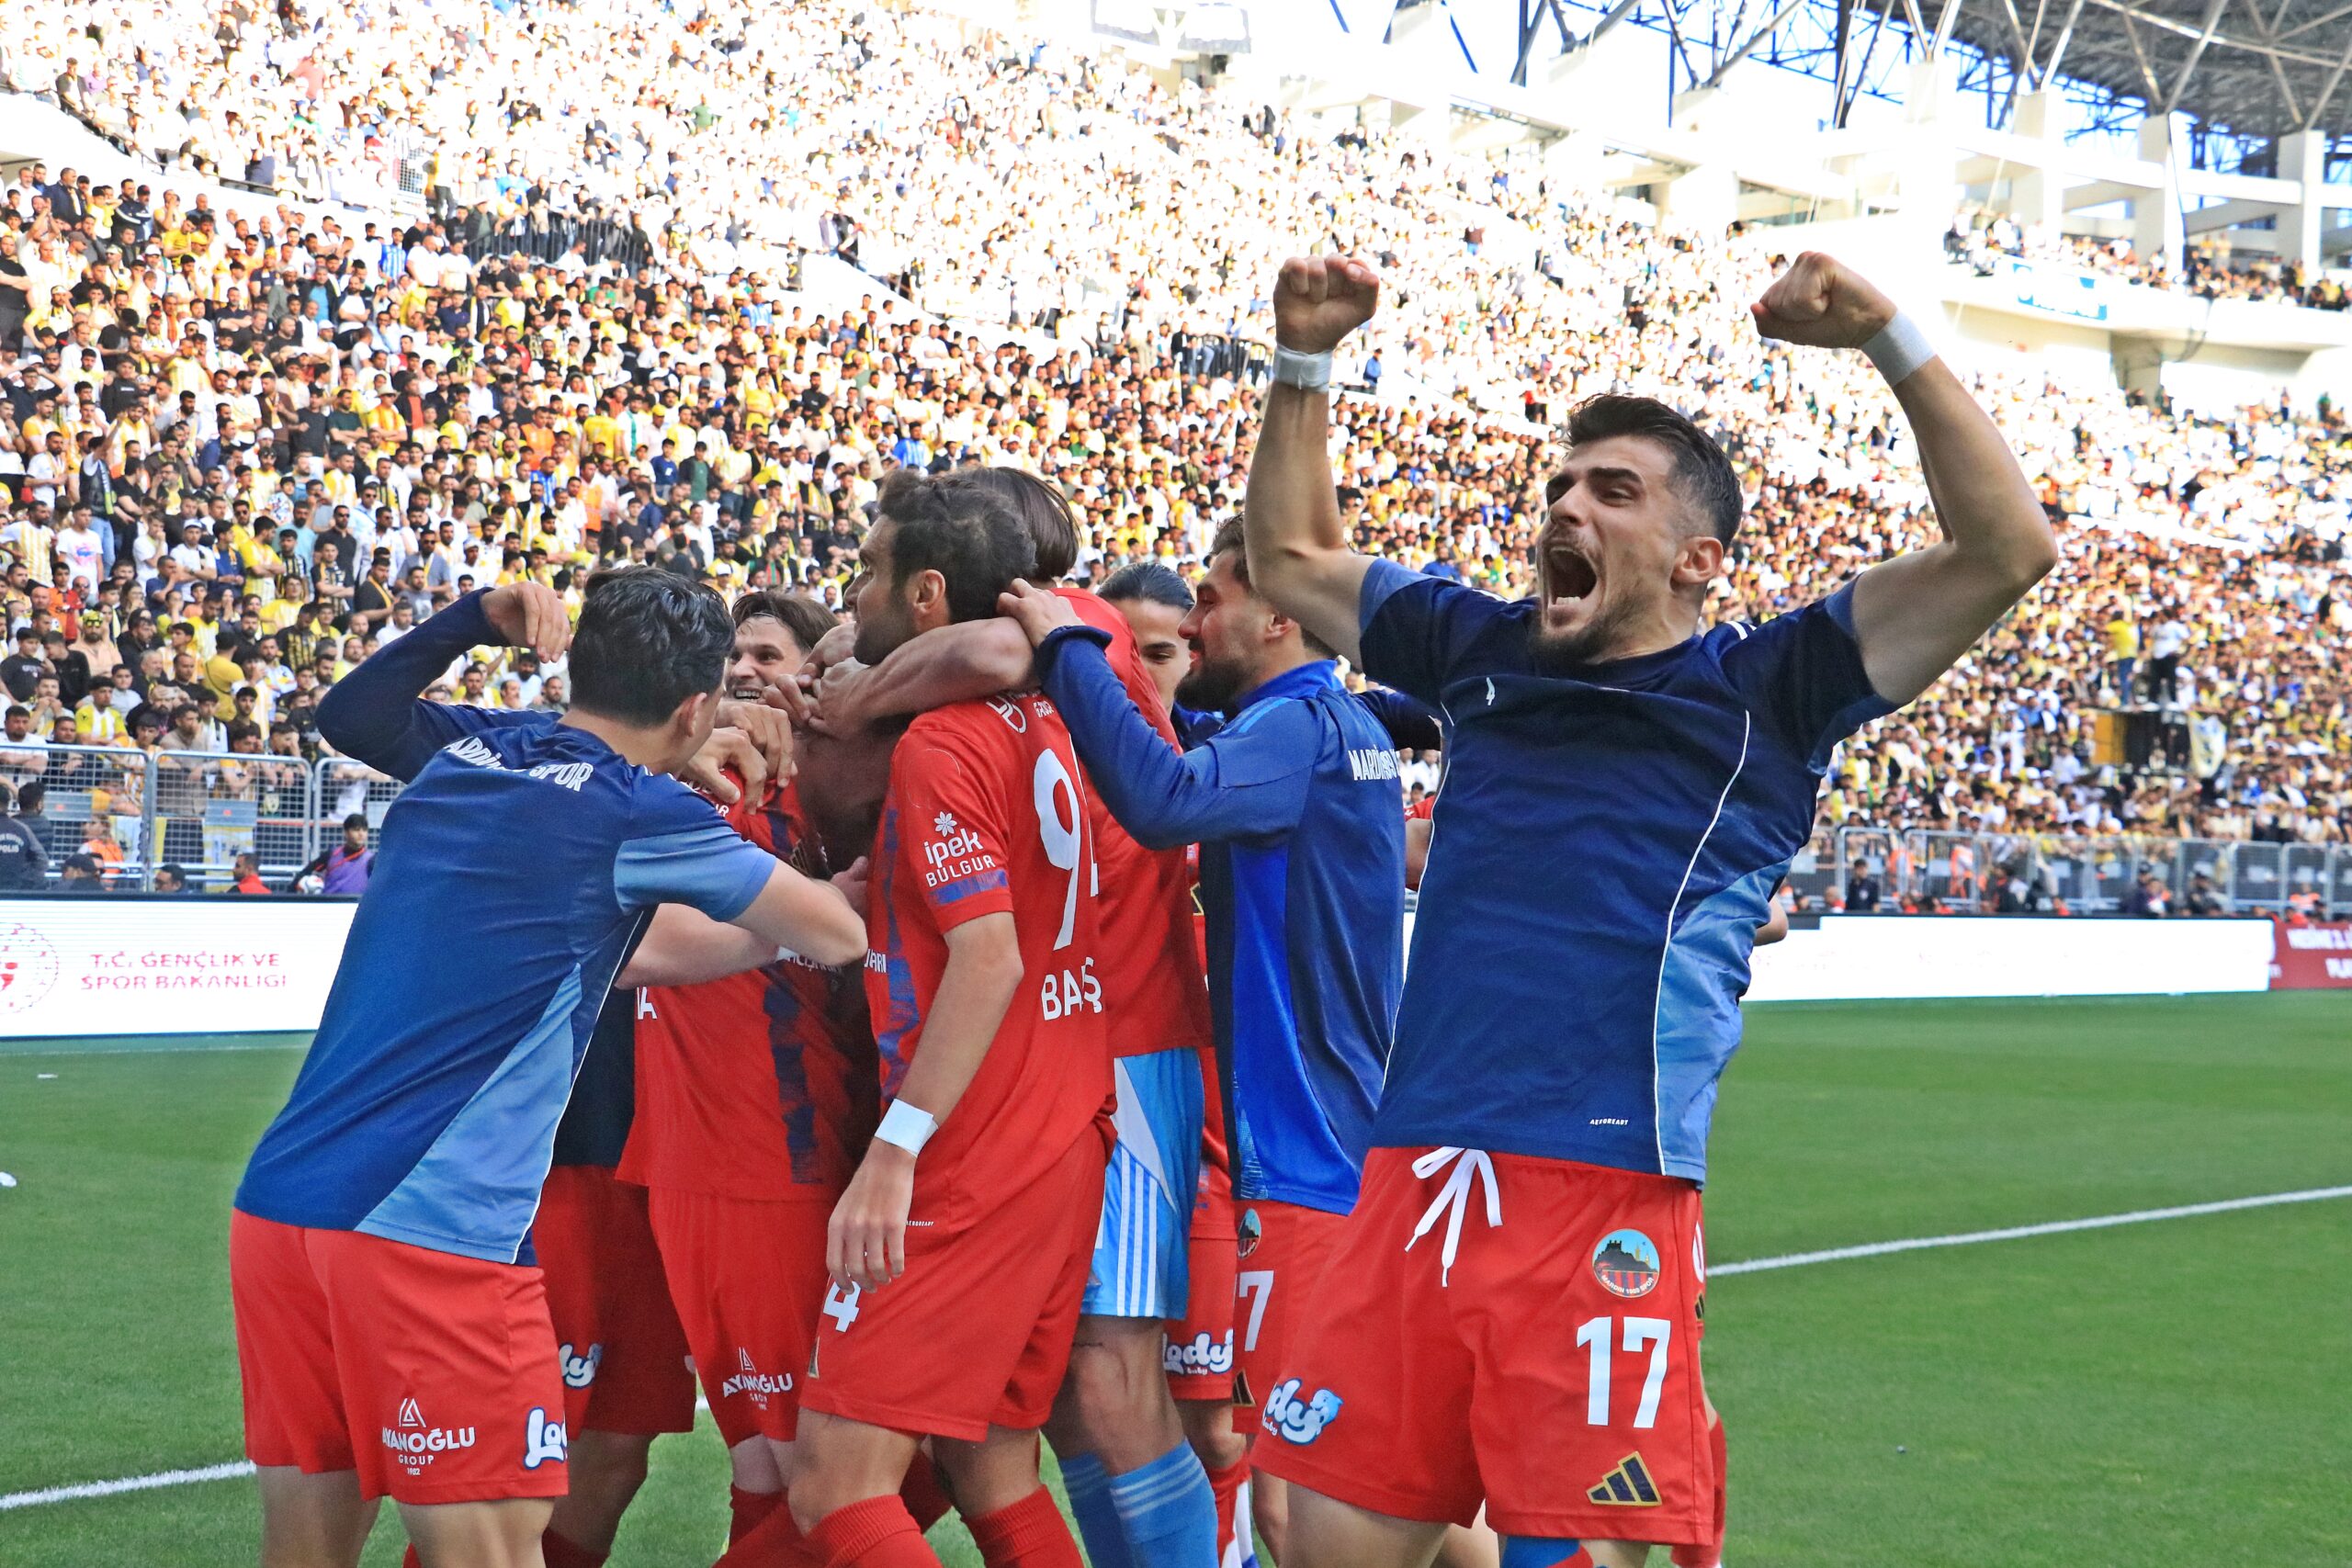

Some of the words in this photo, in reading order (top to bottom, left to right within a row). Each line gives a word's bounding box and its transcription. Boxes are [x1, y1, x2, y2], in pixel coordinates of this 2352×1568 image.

[923, 829, 984, 868] ipek
[926, 855, 996, 887] BULGUR
[253, 953, 279, 966] VE
[81, 974, 147, 989] SPOR
[1577, 1316, 1671, 1428] 17
[398, 1454, 435, 1465] GROUP
